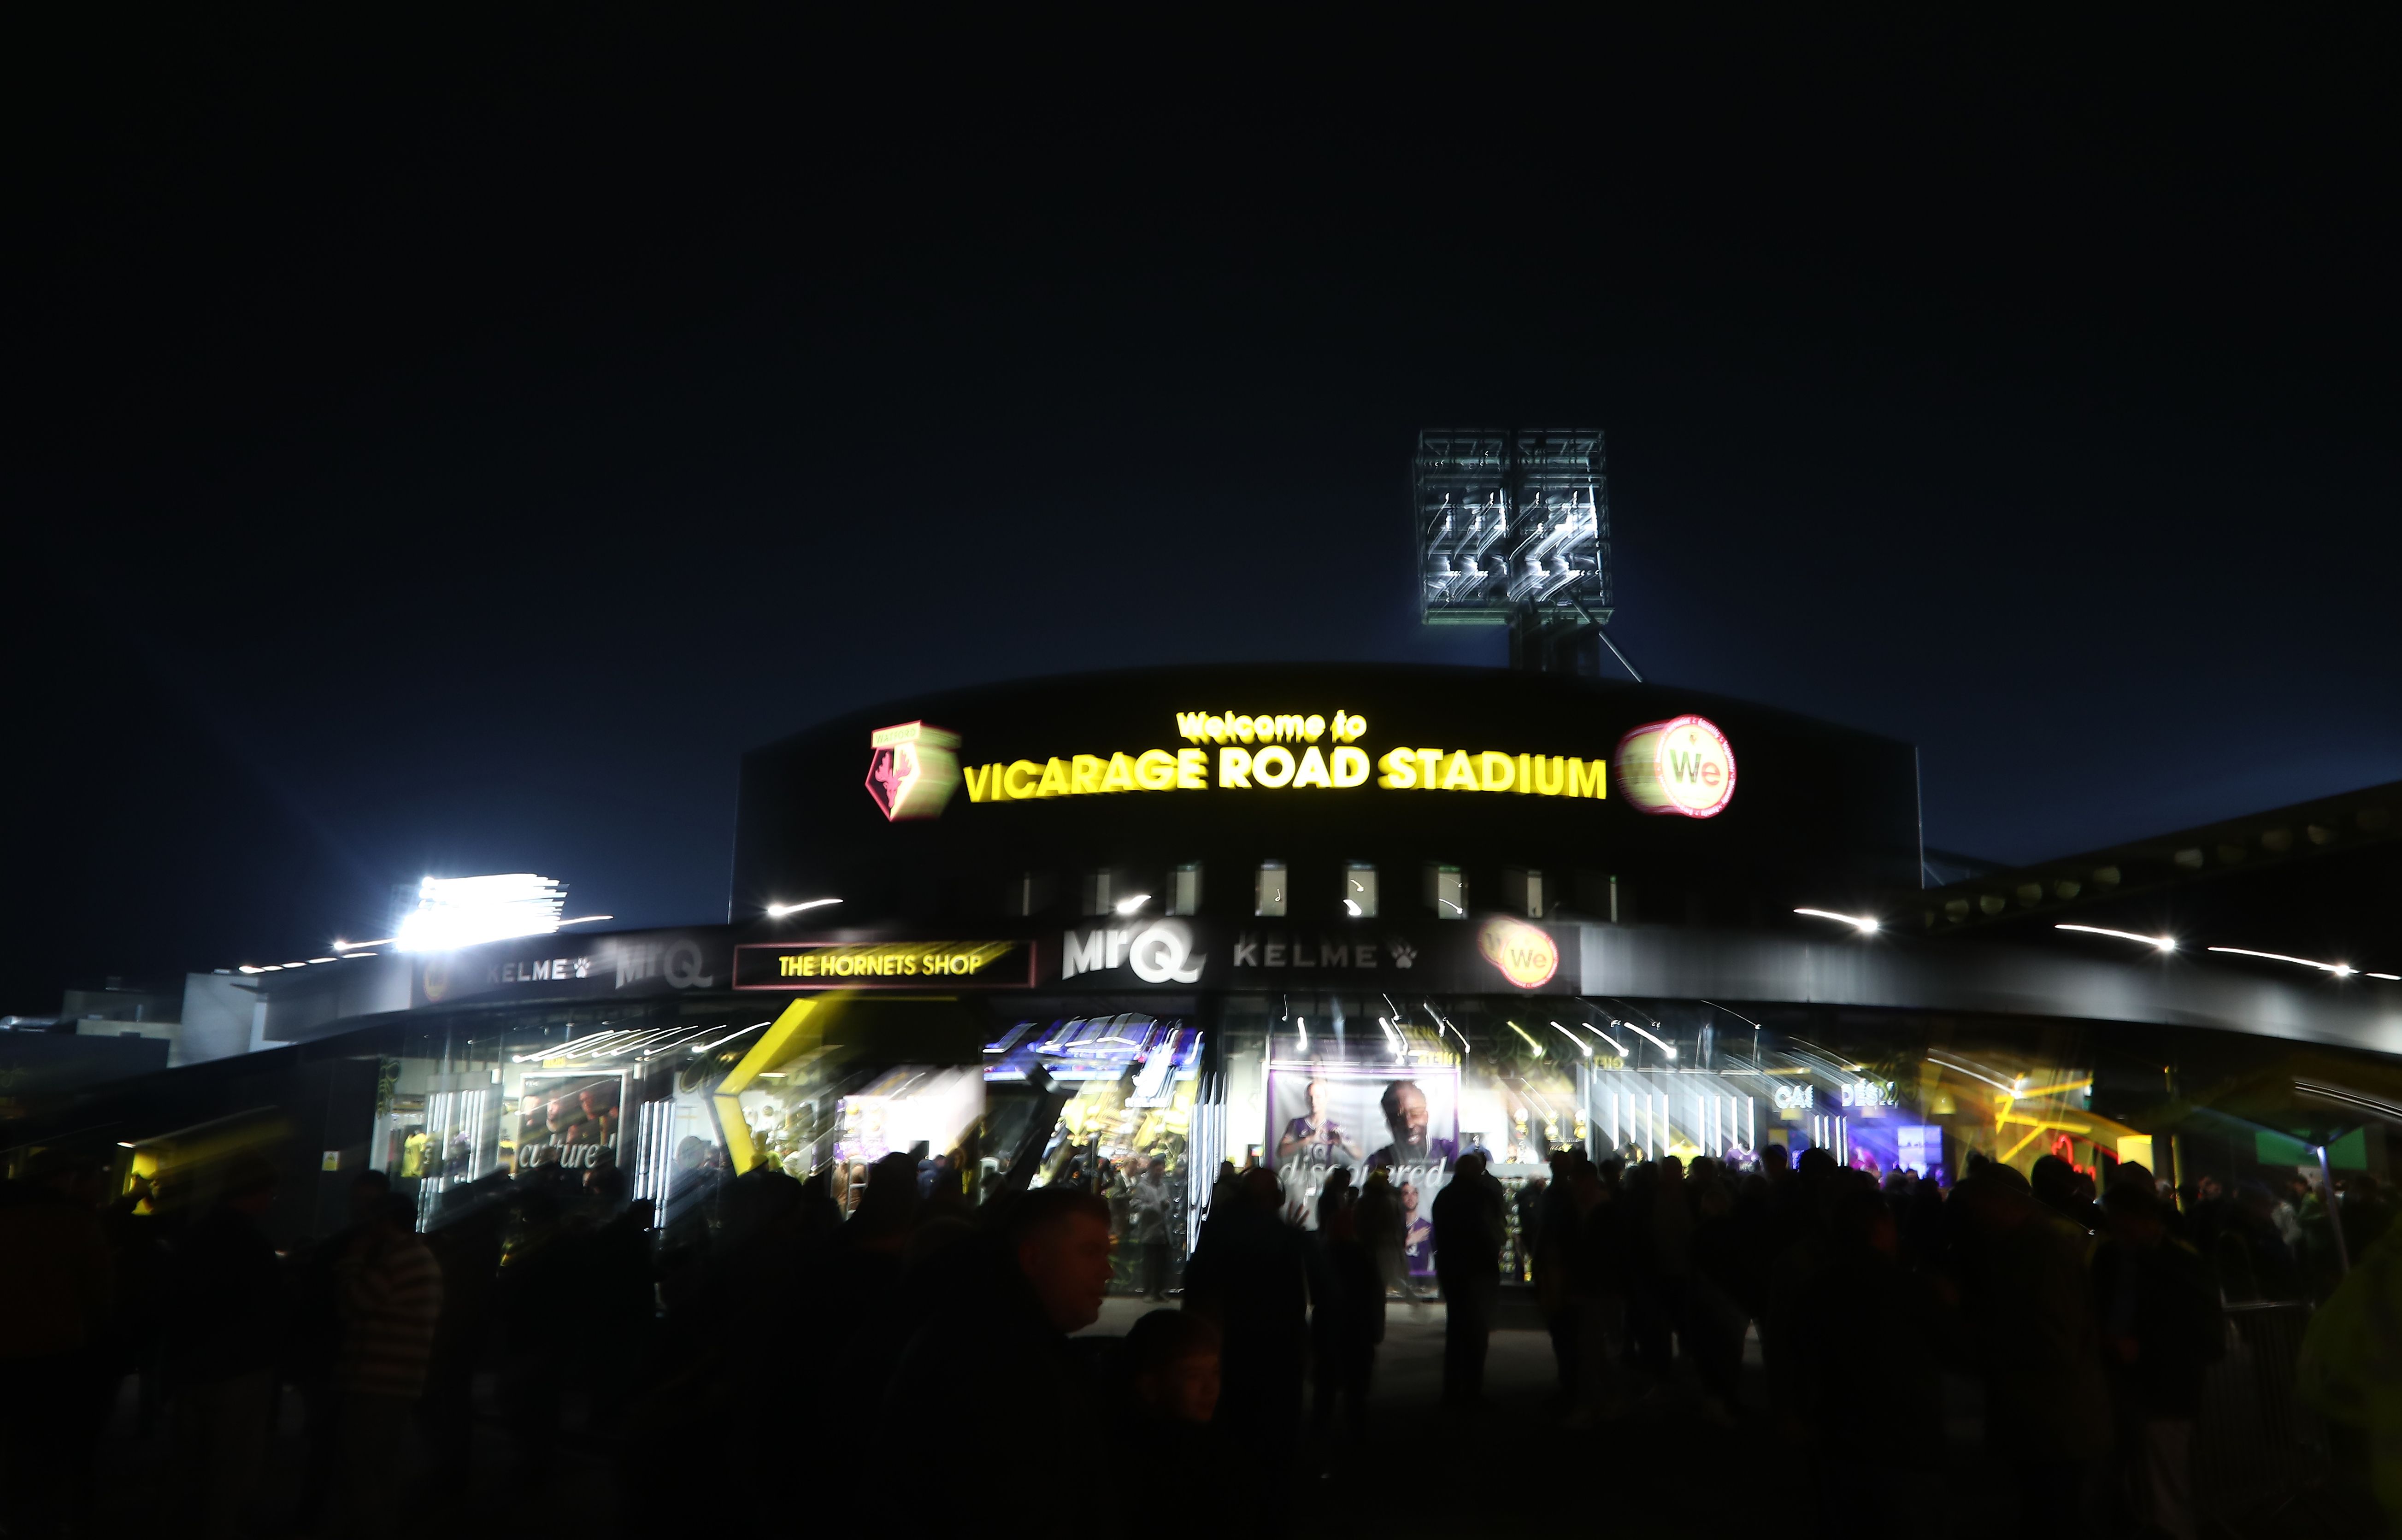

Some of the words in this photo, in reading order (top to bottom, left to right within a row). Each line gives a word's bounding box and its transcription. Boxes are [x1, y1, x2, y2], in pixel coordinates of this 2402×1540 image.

[1176, 710, 1325, 744] Welcome
[1331, 710, 1367, 743] to
[963, 747, 1208, 803] VICARAGE
[1219, 745, 1371, 789] ROAD
[1377, 746, 1607, 799] STADIUM
[1669, 749, 1721, 786] We
[615, 941, 713, 990] MrQ
[779, 955, 815, 977] THE
[820, 954, 916, 977] HORNETS
[922, 954, 983, 976] SHOP
[1062, 926, 1201, 984] MrQ
[1233, 943, 1378, 967] KELME
[1510, 949, 1547, 969] We
[487, 958, 568, 984] KELME
[1841, 1078, 1895, 1107] DES
